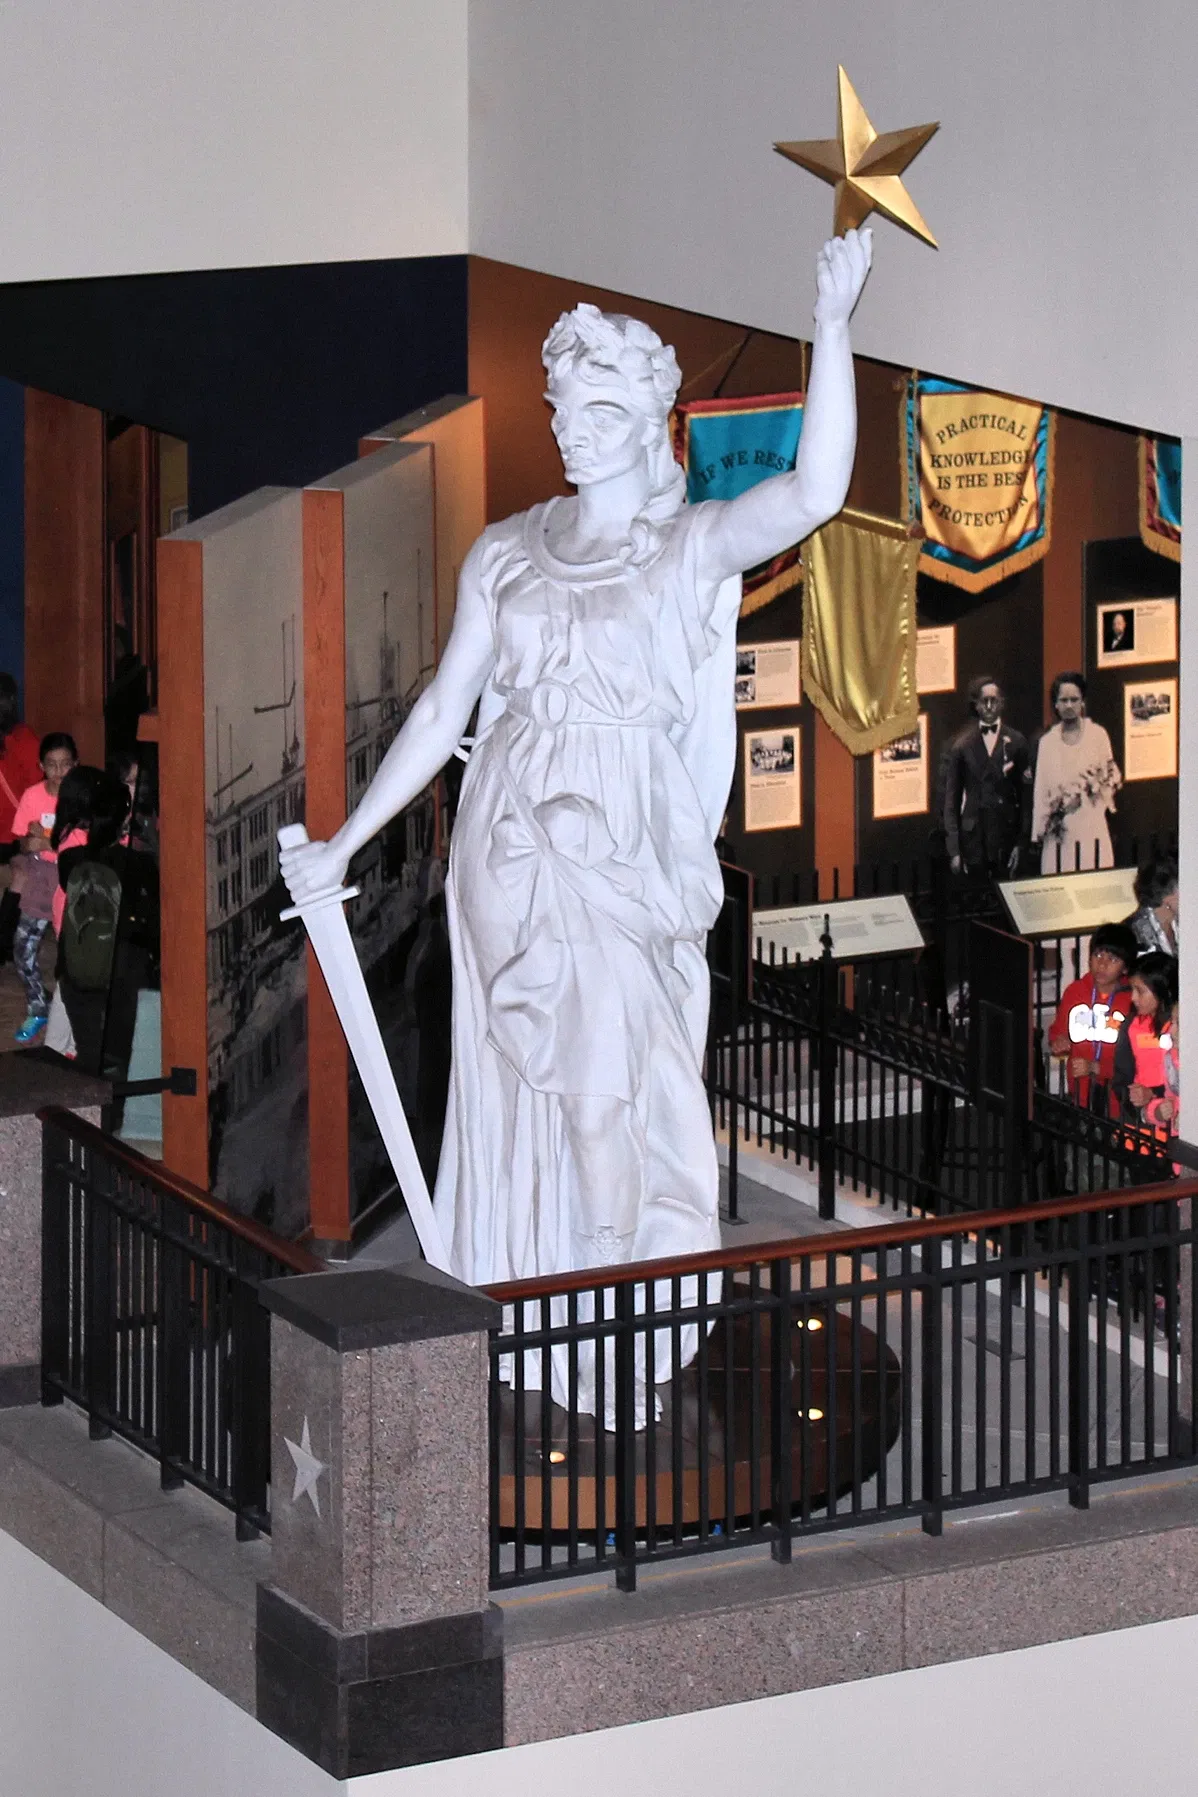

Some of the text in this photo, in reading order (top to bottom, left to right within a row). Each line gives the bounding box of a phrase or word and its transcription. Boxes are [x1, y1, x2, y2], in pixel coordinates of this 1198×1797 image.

[936, 414, 1027, 443] PRACTICAL
[700, 463, 716, 484] IF
[720, 450, 748, 470] WE
[937, 471, 1025, 490] IS THE BES
